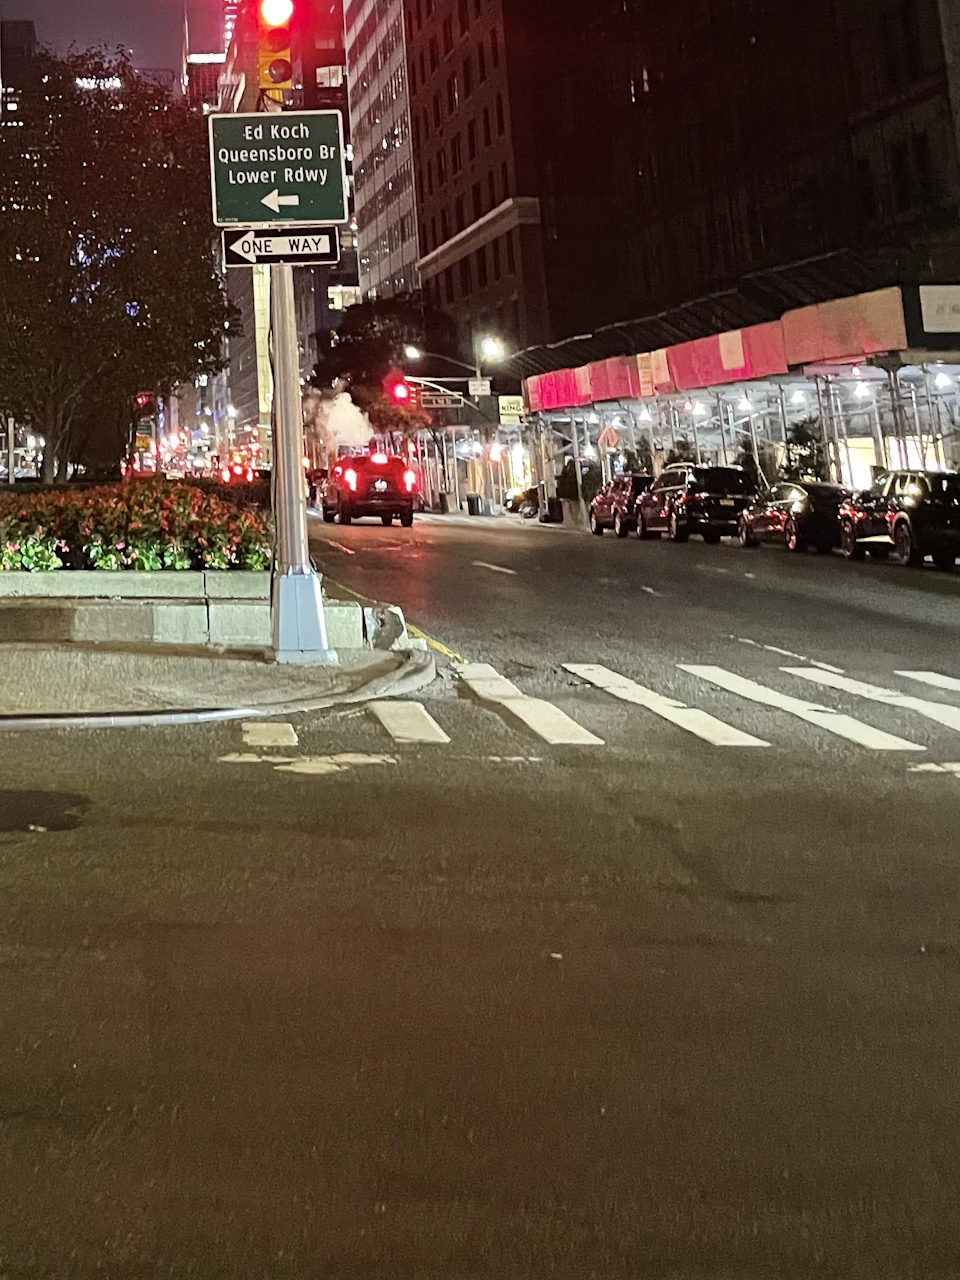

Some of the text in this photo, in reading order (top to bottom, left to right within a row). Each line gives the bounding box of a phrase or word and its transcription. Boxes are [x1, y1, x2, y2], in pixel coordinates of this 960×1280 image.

[245, 123, 310, 141] Ed Koch
[218, 144, 336, 163] Queensboro Br
[228, 167, 328, 185] Lower Rdwy
[241, 237, 322, 254] ONE WAY
